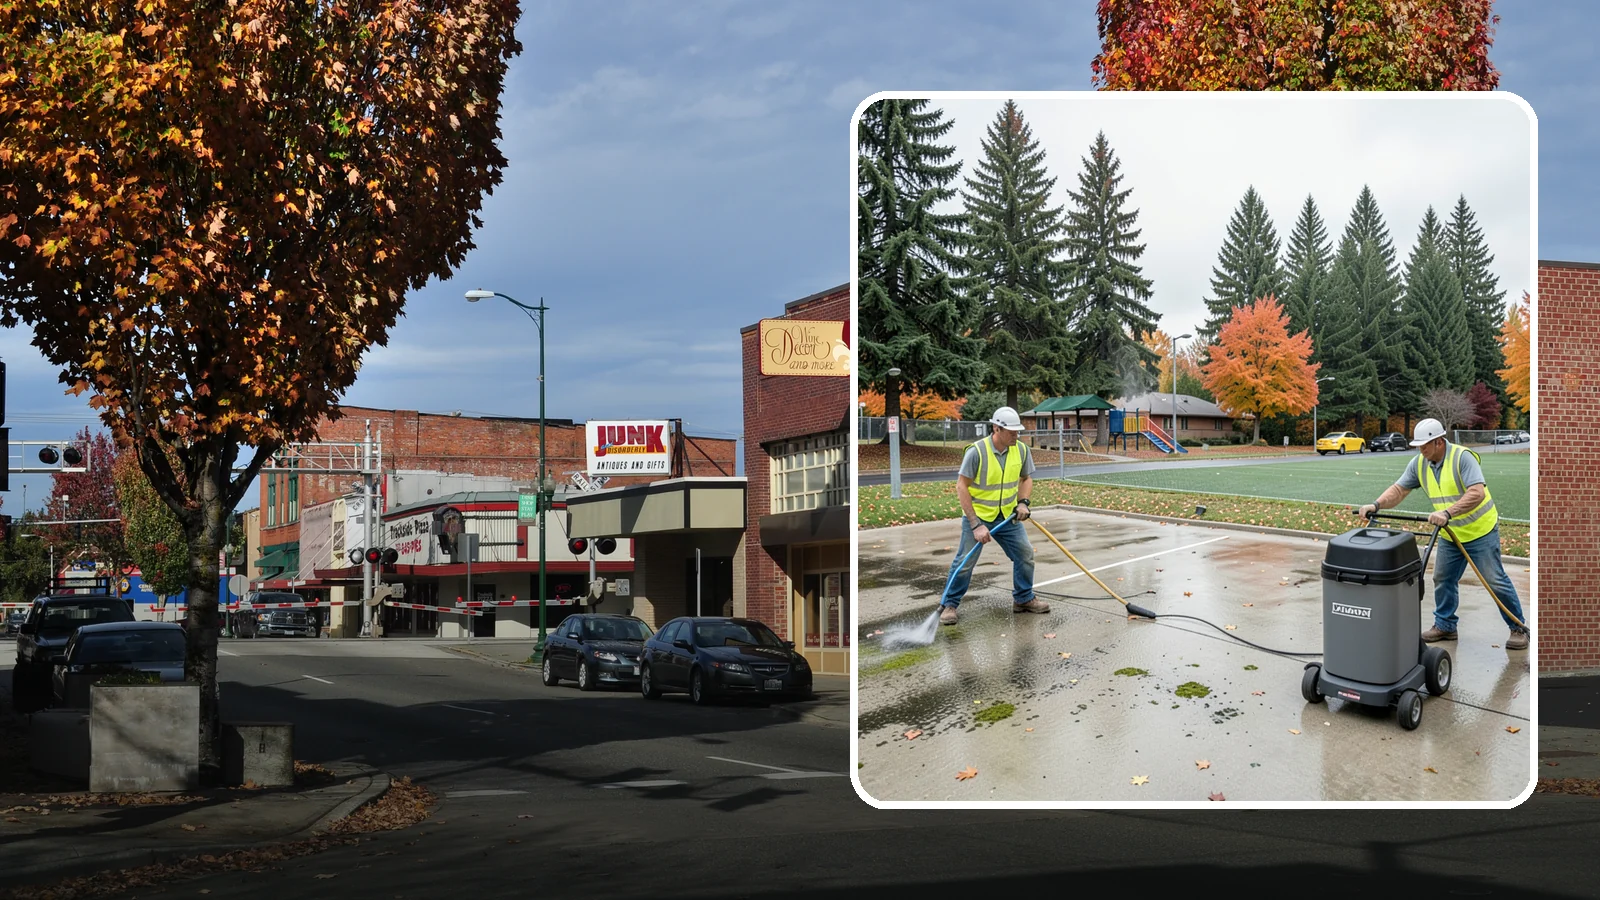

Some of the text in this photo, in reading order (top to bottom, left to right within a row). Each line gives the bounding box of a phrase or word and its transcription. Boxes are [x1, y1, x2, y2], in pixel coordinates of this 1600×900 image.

[765, 327, 830, 365] Decor
[595, 425, 665, 457] JUNK
[607, 446, 646, 454] DISORDERLY
[597, 461, 665, 470] ANTIQUES AND GIFTS
